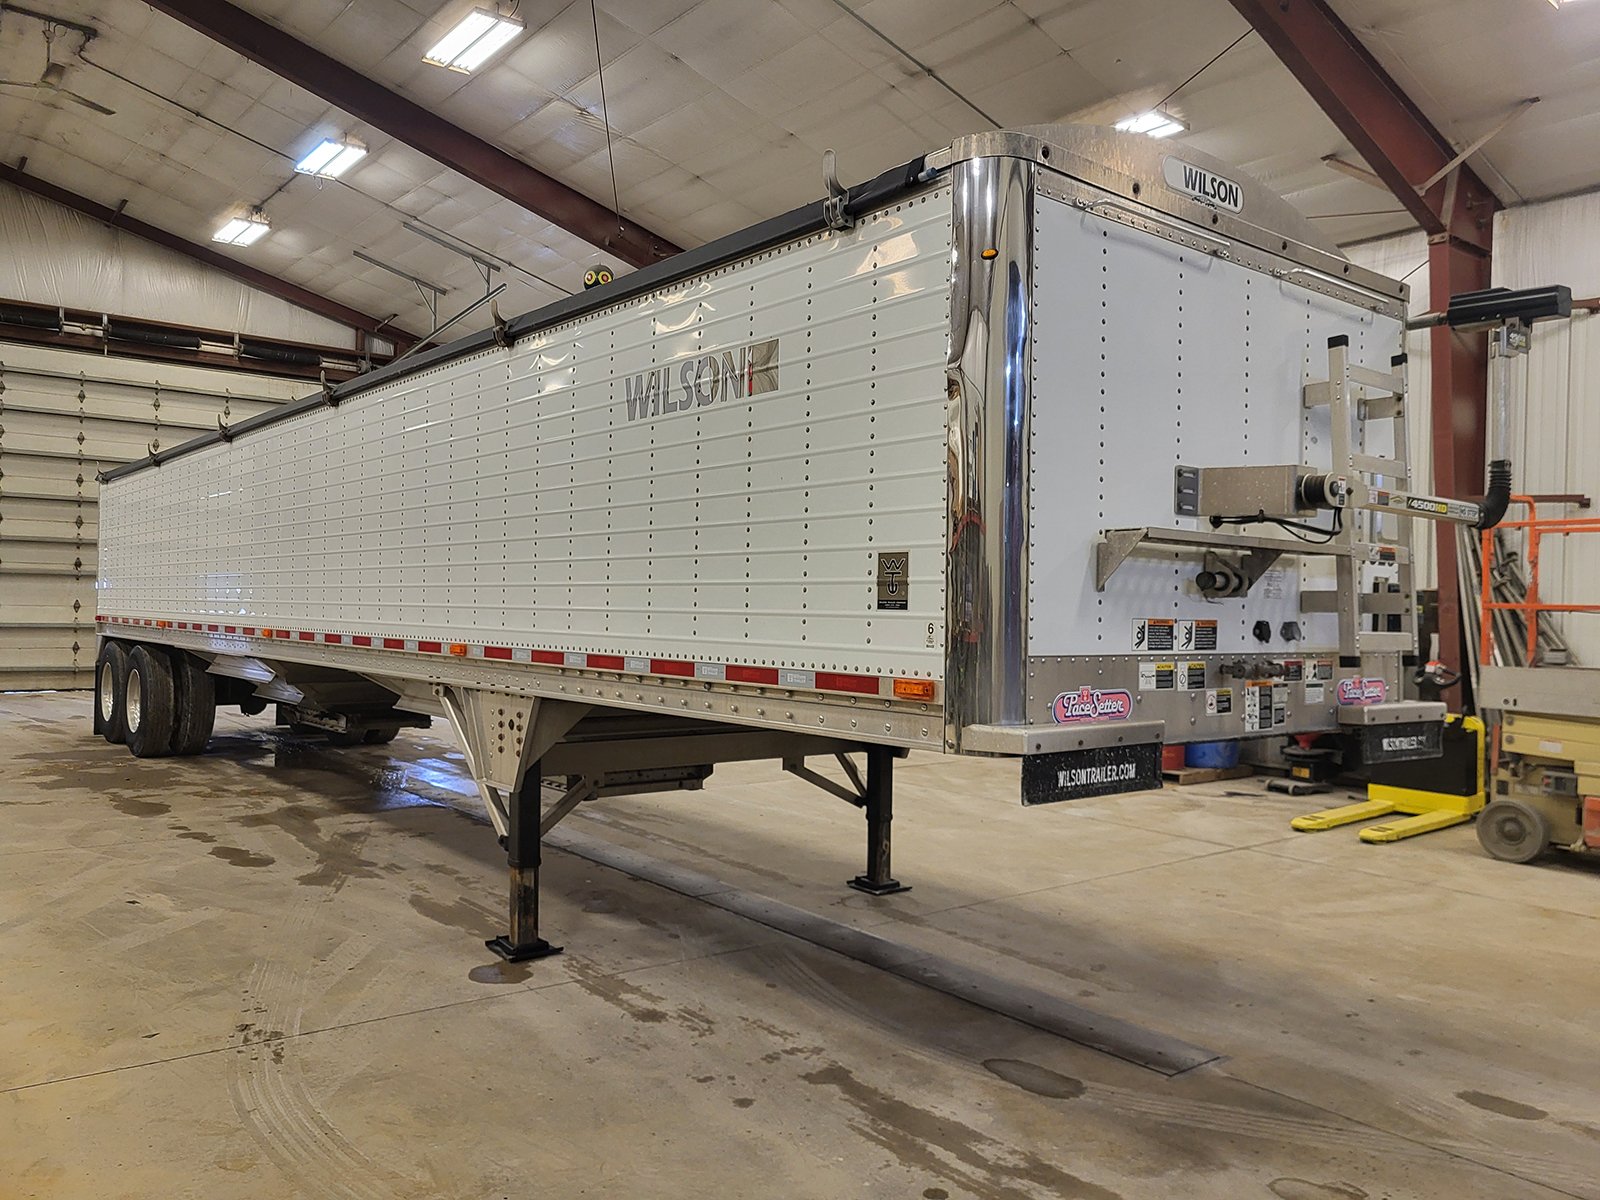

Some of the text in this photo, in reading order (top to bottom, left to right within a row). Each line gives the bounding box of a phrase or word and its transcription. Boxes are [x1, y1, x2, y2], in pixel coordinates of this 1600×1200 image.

[1183, 165, 1238, 208] WILSON
[624, 347, 746, 422] WILSON
[927, 622, 935, 635] 6
[1057, 763, 1137, 788] WILSONTRAILER.COM
